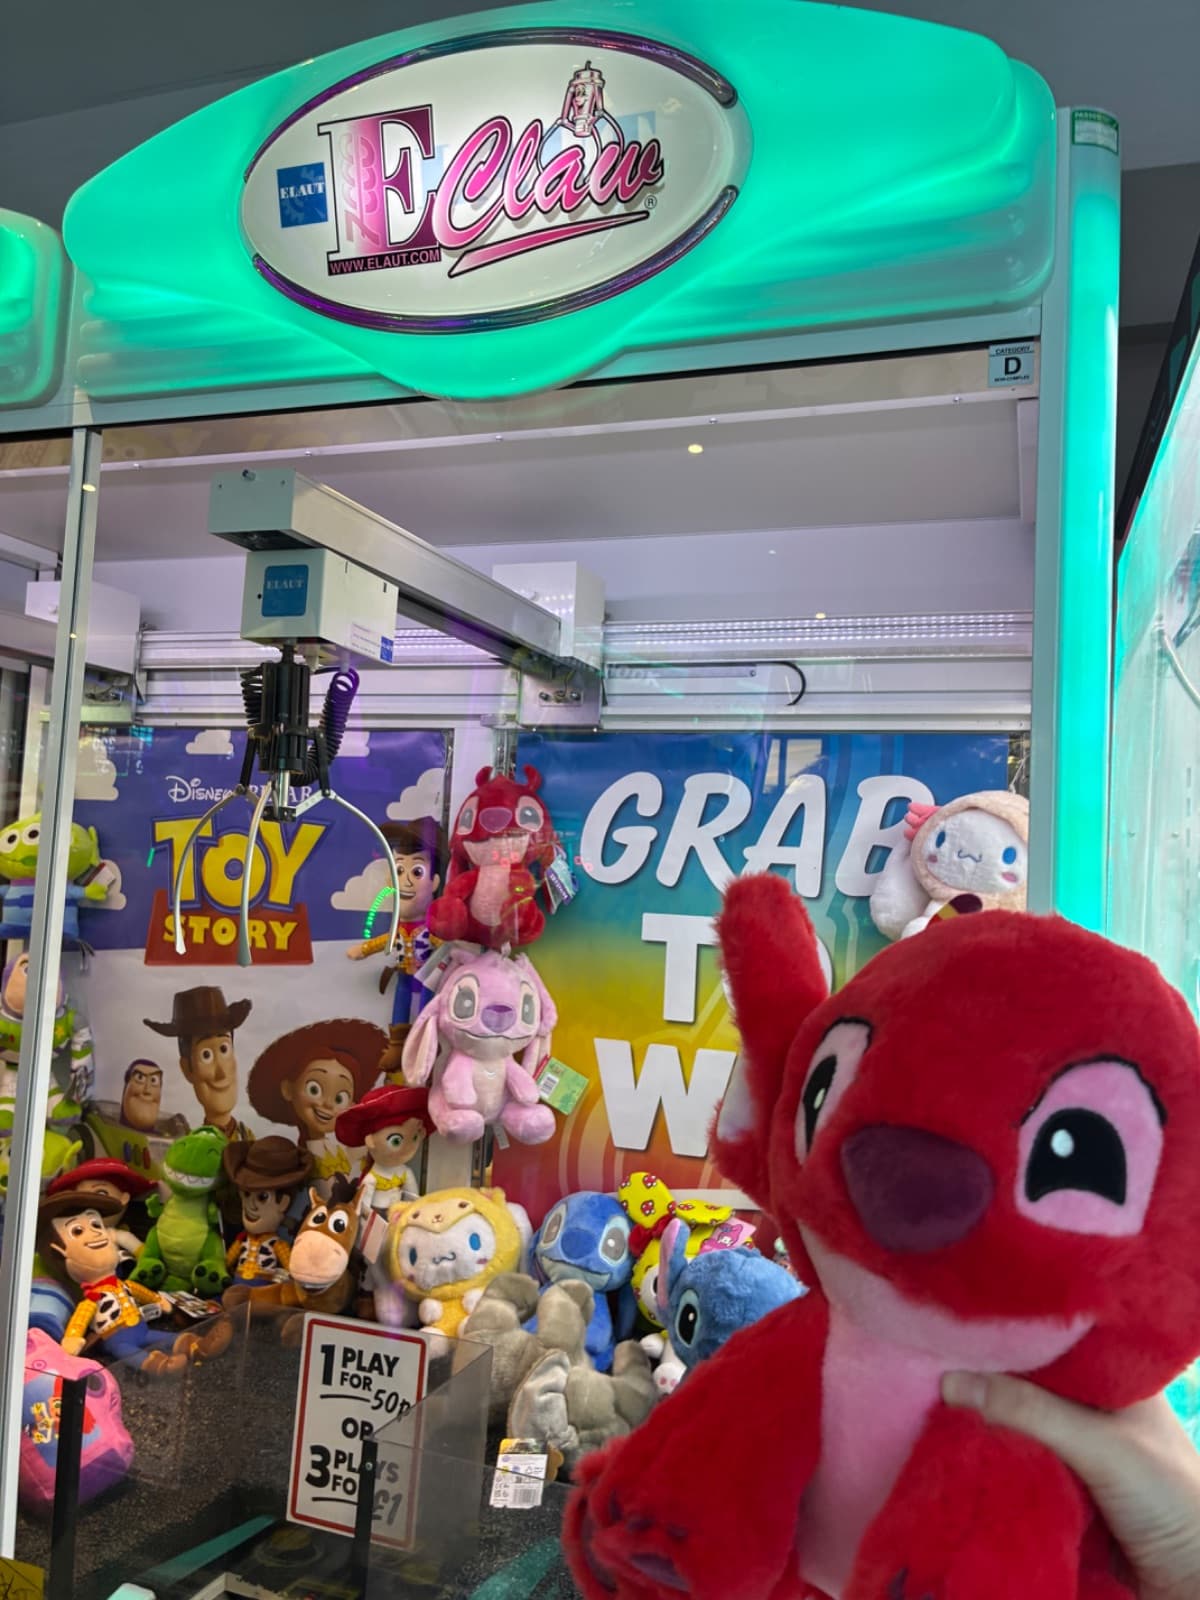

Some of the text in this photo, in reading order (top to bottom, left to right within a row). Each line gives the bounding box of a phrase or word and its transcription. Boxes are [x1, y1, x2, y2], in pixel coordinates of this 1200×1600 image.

[280, 182, 325, 199] ELAUT
[329, 250, 440, 274] WWW.ELAUT.COM
[1004, 356, 1022, 376] D
[266, 579, 304, 590] ELAUT
[249, 784, 312, 803] PAR
[153, 817, 328, 909] TOY
[163, 914, 298, 950] STORY
[320, 1344, 400, 1386] 1 PLAY
[340, 1371, 411, 1421] FOR 50p
[305, 1445, 399, 1488] 3 PLYS
[332, 1474, 358, 1496] FO
